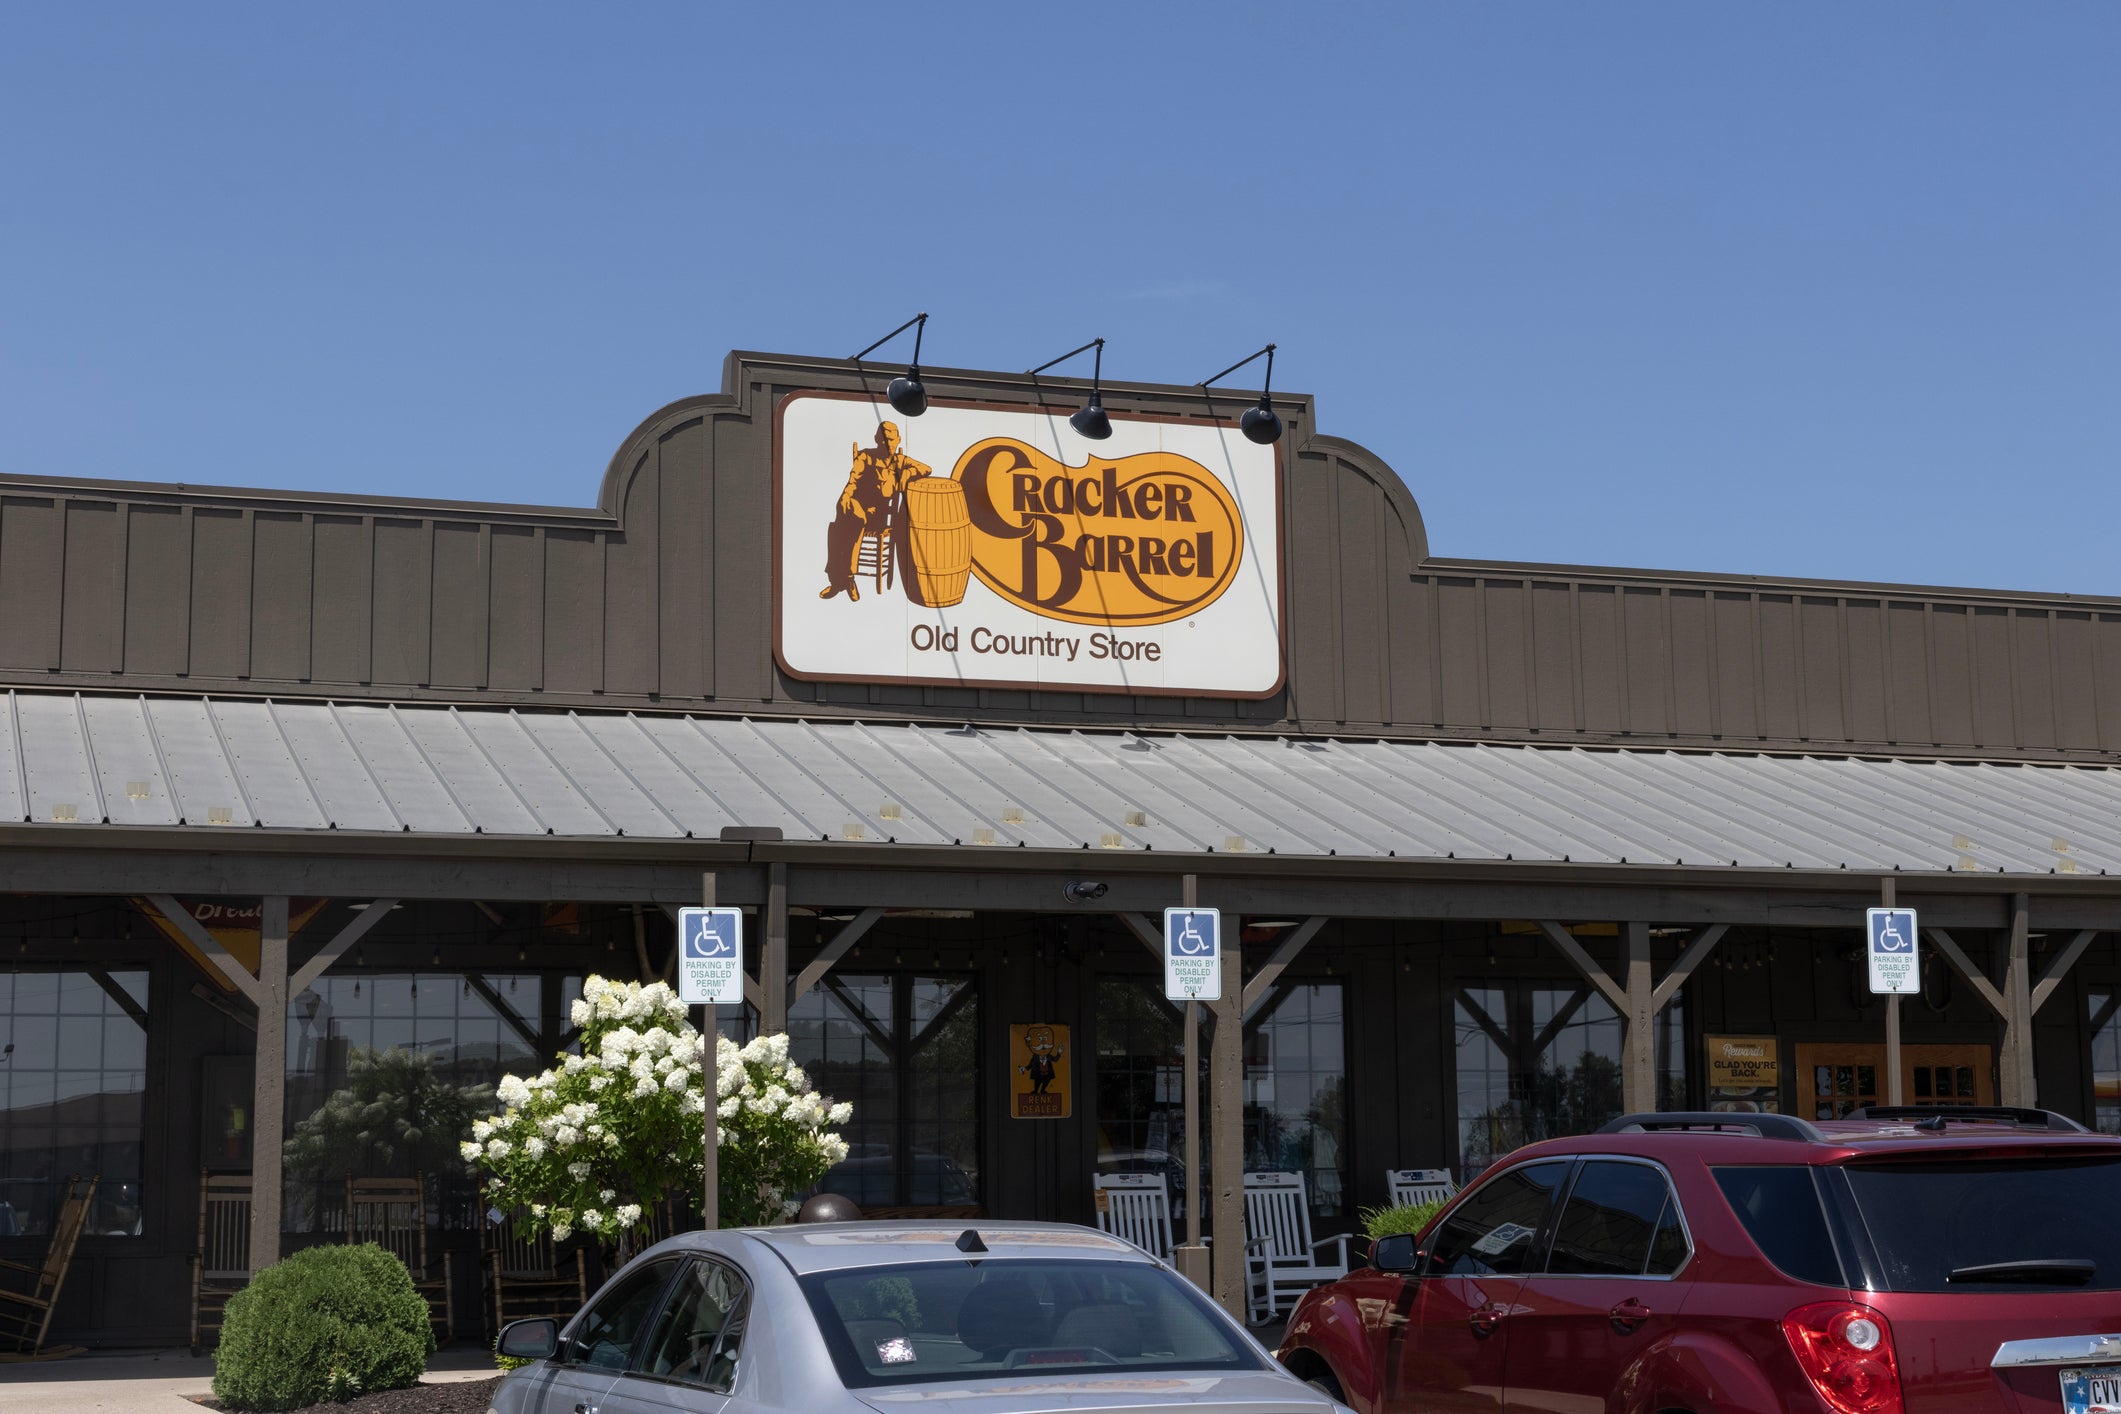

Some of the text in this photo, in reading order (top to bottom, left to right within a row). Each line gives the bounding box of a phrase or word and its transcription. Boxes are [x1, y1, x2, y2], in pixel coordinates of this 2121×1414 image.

[910, 623, 1161, 662] Old Country Store
[685, 961, 736, 969] PARKING BY
[1170, 959, 1202, 967] PARKING
[690, 970, 732, 978] DISABLED
[1175, 968, 1211, 976] DISABLED
[696, 979, 727, 987] PERMIT
[1179, 977, 1206, 985] PERMIT
[1886, 980, 1903, 988] ONLY
[701, 988, 722, 997] ONLY
[1184, 985, 1202, 994] ONLY
[1722, 1043, 1764, 1058] Rewards
[1713, 1060, 1777, 1070] GLAD YOU'RE
[1731, 1069, 1760, 1078] BACK.
[1022, 1105, 1058, 1114] DEALER
